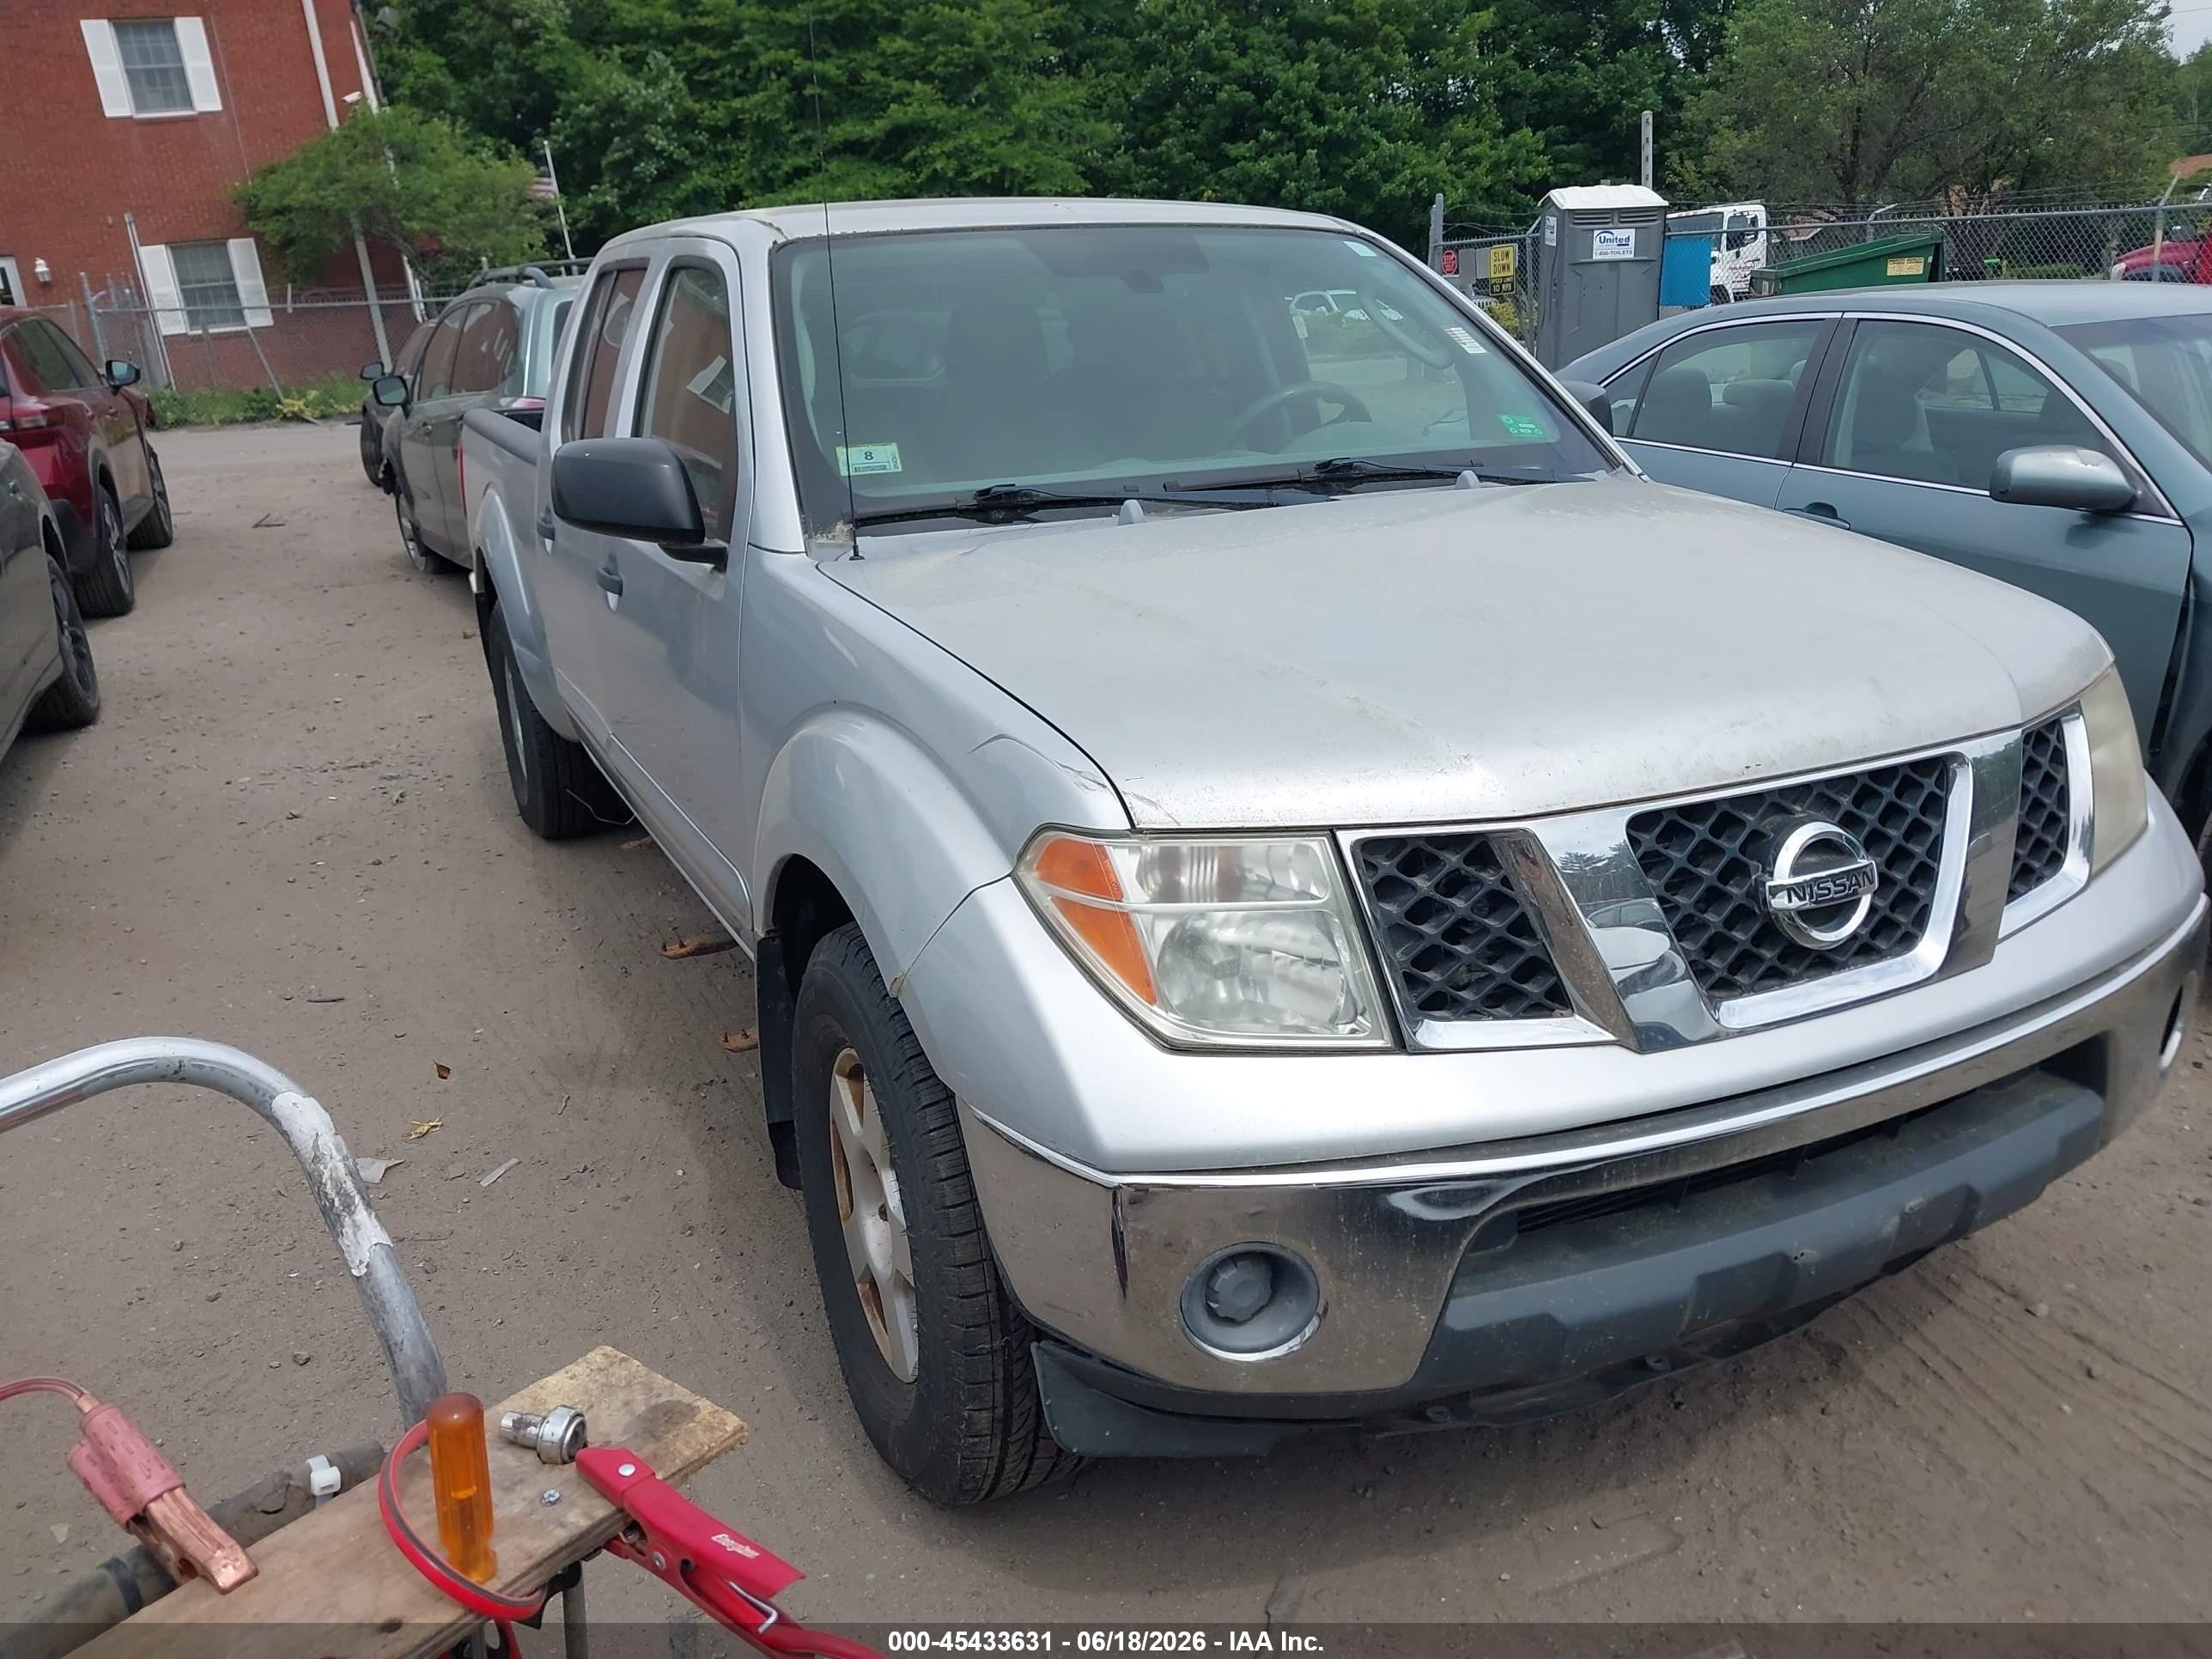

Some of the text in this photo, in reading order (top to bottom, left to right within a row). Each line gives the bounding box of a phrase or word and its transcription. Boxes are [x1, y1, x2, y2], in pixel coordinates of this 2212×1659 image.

[1599, 234, 1631, 244] United
[1493, 250, 1510, 262] SLOW
[1493, 263, 1510, 275] DOWN
[864, 451, 874, 461] 8
[1785, 868, 1875, 905] NISSAN
